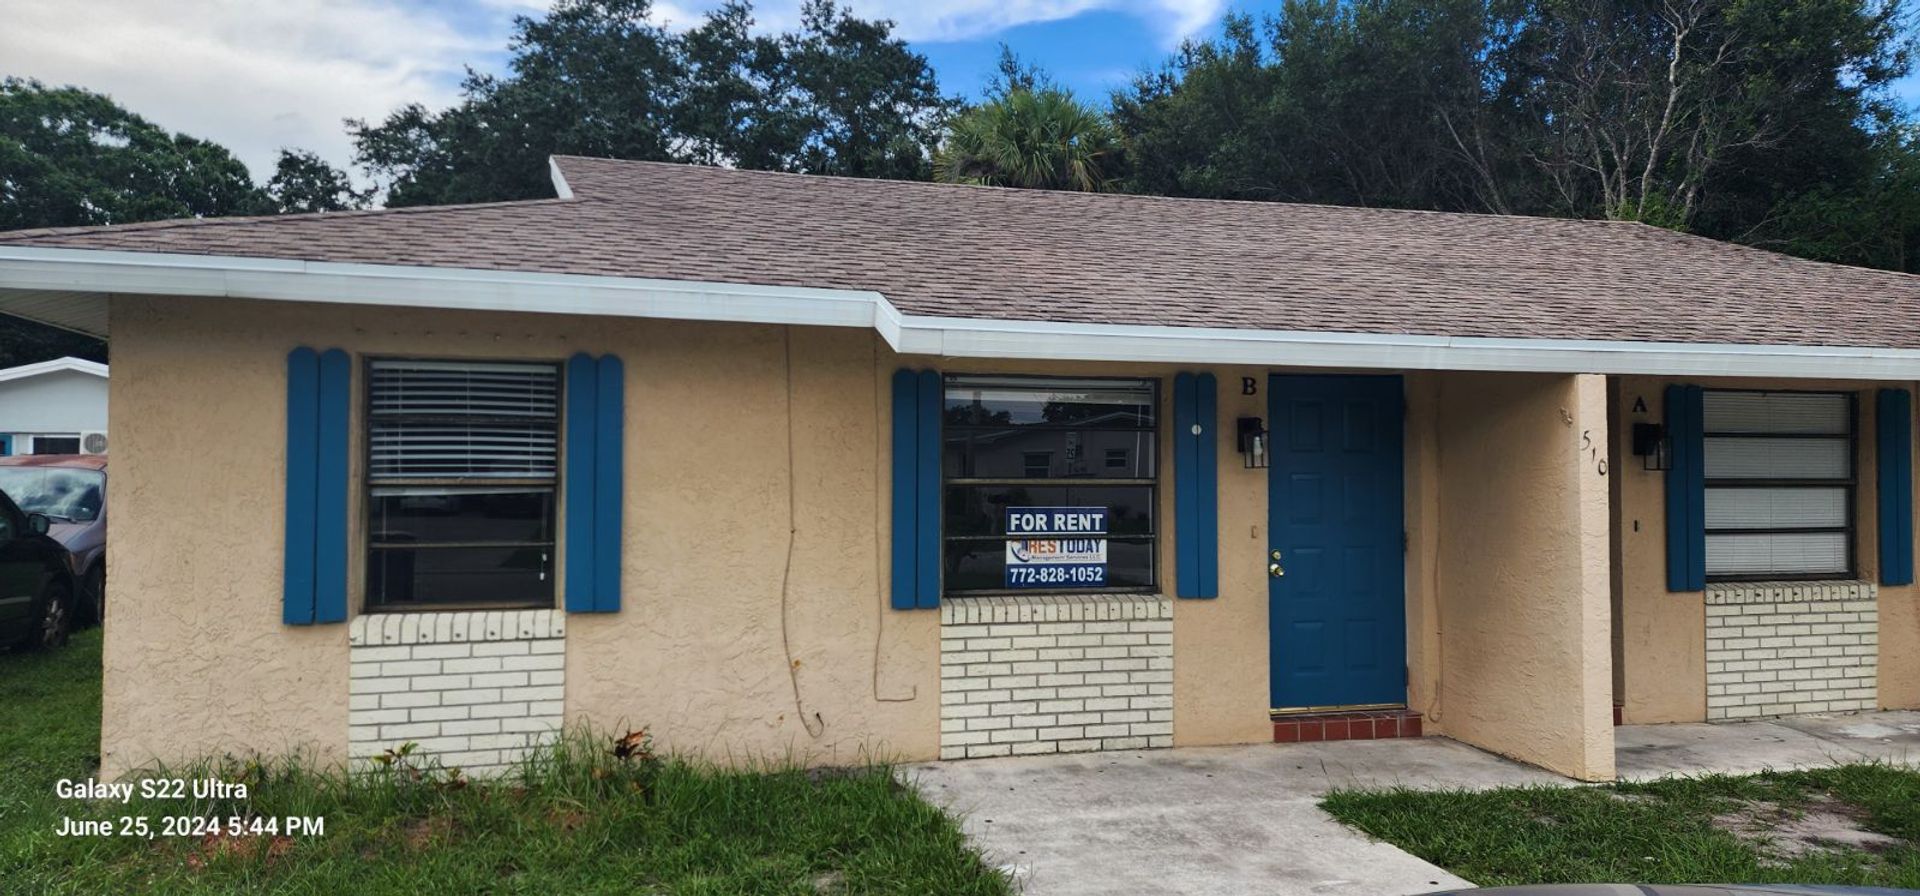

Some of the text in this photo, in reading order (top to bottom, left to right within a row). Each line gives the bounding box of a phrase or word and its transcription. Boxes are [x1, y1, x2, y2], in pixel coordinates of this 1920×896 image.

[1242, 376, 1257, 396] B
[1632, 395, 1648, 412] A
[1580, 430, 1607, 476] 510
[1010, 513, 1104, 531] FOR RENT
[1010, 567, 1103, 583] 772-828-1052
